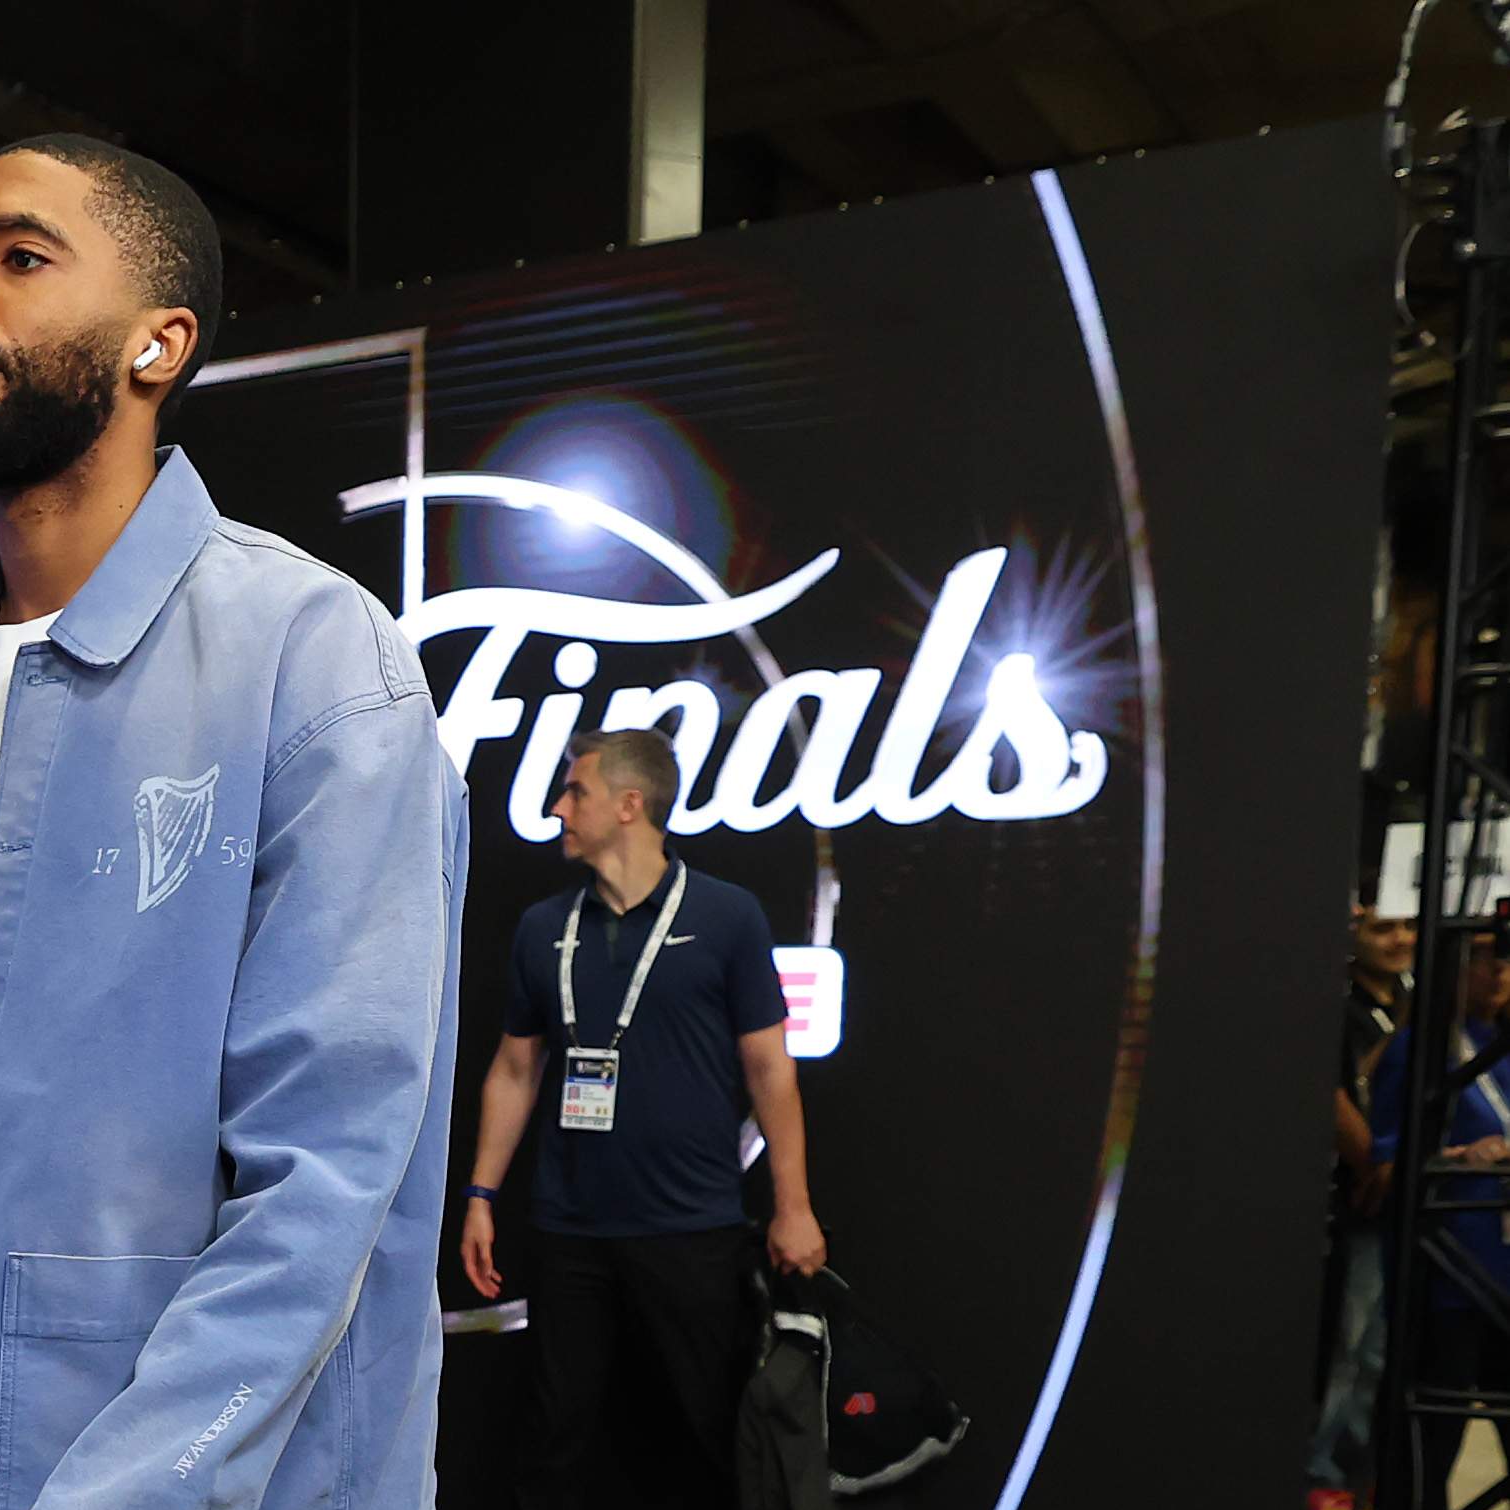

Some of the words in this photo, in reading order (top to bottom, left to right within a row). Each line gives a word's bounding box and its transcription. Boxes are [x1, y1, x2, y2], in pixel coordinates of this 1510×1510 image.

[395, 546, 1109, 843] Finals
[91, 848, 121, 875] 17
[221, 836, 253, 868] 59
